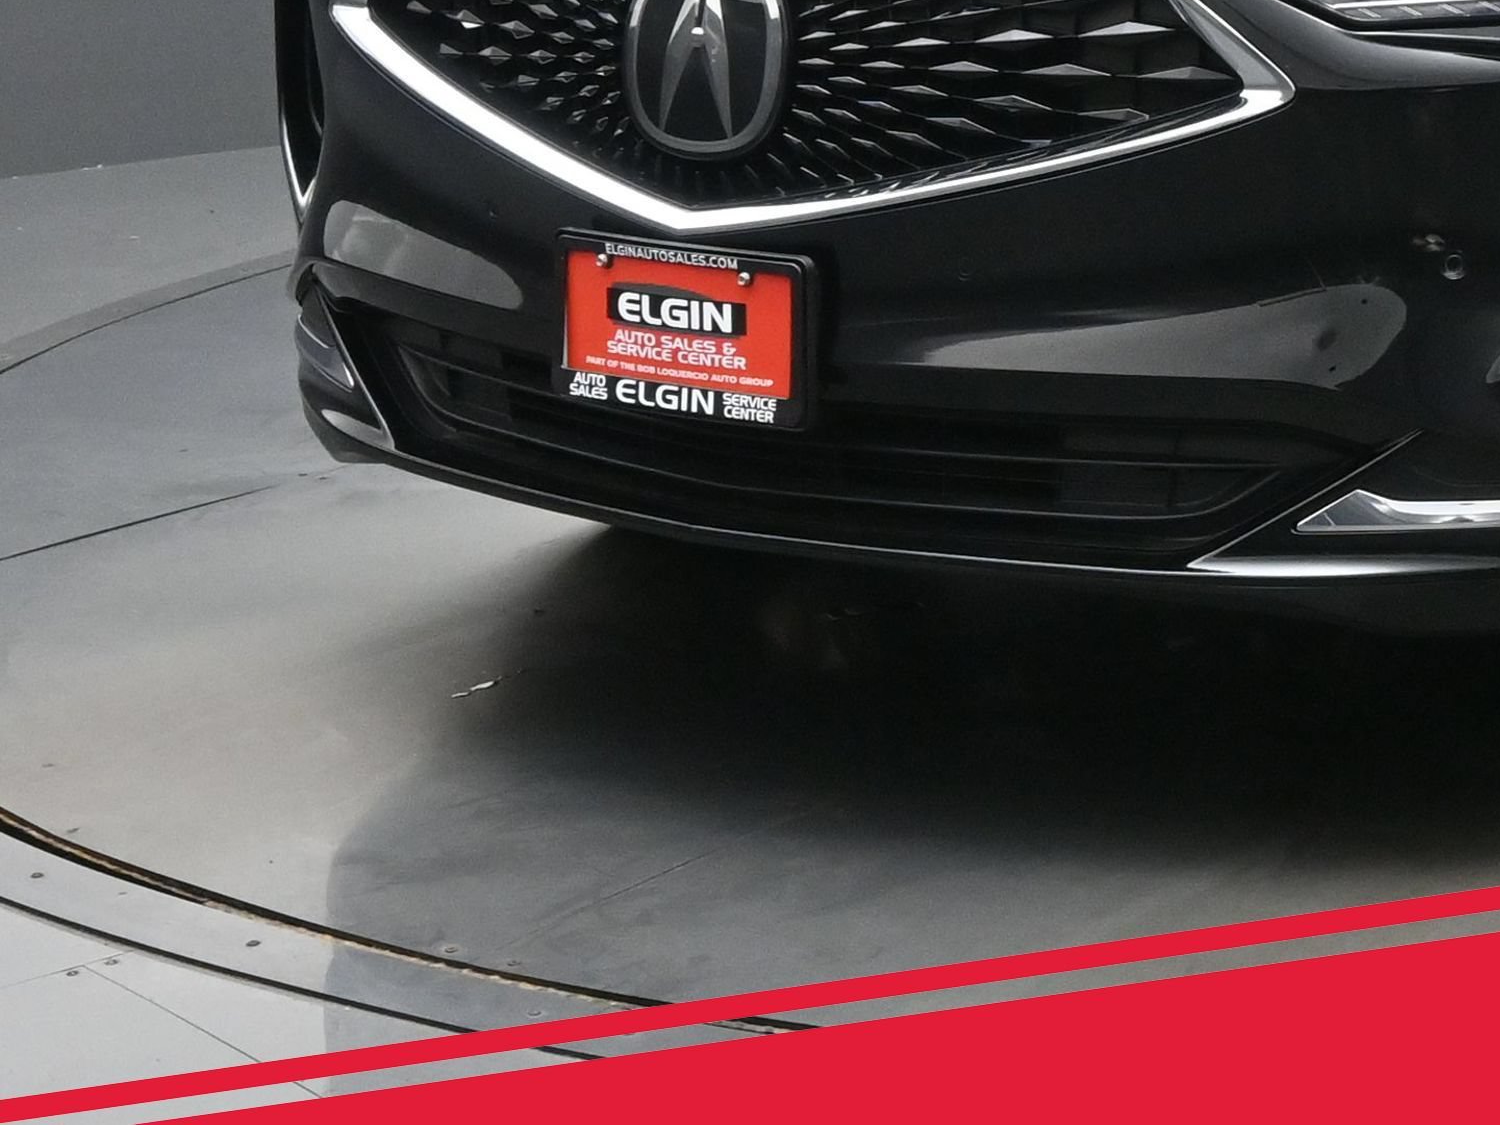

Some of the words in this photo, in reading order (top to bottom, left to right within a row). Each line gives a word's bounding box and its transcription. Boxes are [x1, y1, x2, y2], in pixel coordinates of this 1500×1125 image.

[605, 242, 739, 270] ELGINAUTOSALES.COM
[617, 291, 733, 333] ELGIN
[614, 328, 656, 346] AUTO
[660, 335, 716, 354] SALES
[722, 342, 736, 355] &
[607, 341, 673, 362] SERVICE
[677, 351, 747, 370] CENTER
[573, 371, 606, 387] AUTO
[586, 355, 606, 366] PART
[606, 359, 619, 368] OF
[620, 361, 636, 371] THE
[711, 374, 737, 385] AUTO
[739, 377, 774, 388] GROUP
[569, 382, 608, 400] SALES
[615, 379, 714, 415] ELGIN
[722, 392, 777, 412] SERVICE
[724, 405, 775, 424] CENTER
